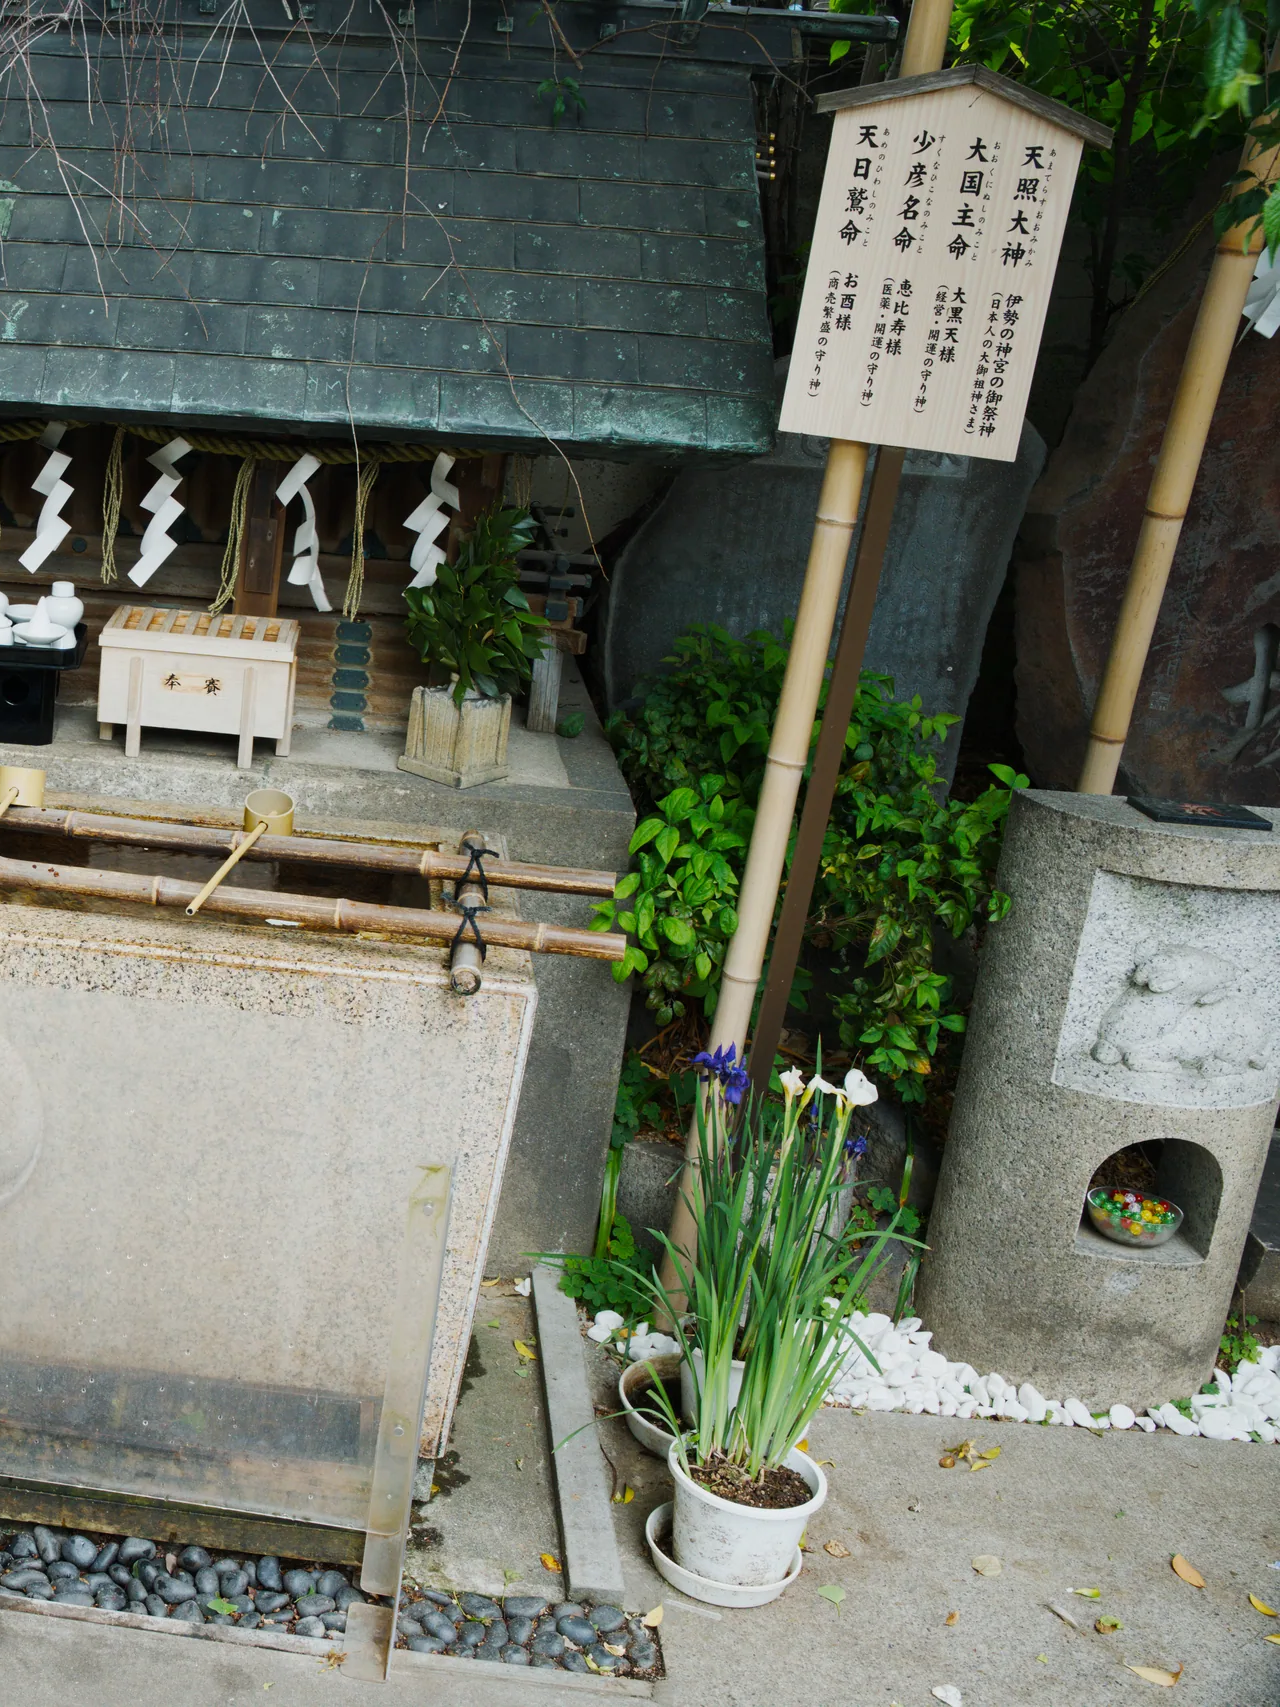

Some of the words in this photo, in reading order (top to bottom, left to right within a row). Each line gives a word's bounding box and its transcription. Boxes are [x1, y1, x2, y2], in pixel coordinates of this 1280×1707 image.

[837, 124, 880, 247] 天日鷲命
[862, 127, 891, 247] あめのひわしのみこと
[892, 129, 936, 254] 少彦名命
[916, 134, 947, 254] すくなひこなのみこと
[946, 136, 989, 261] 大国主命
[971, 141, 1001, 262] おおくにぬしのみこと
[1000, 145, 1045, 269] 天照大神
[1024, 148, 1057, 267] あまてらすおおみかみ
[834, 272, 859, 332] お酉様
[884, 278, 914, 357] 恵比寿様
[938, 286, 967, 364] 大黒天様
[978, 293, 1024, 438] 伊勢の神宮の御祭神
